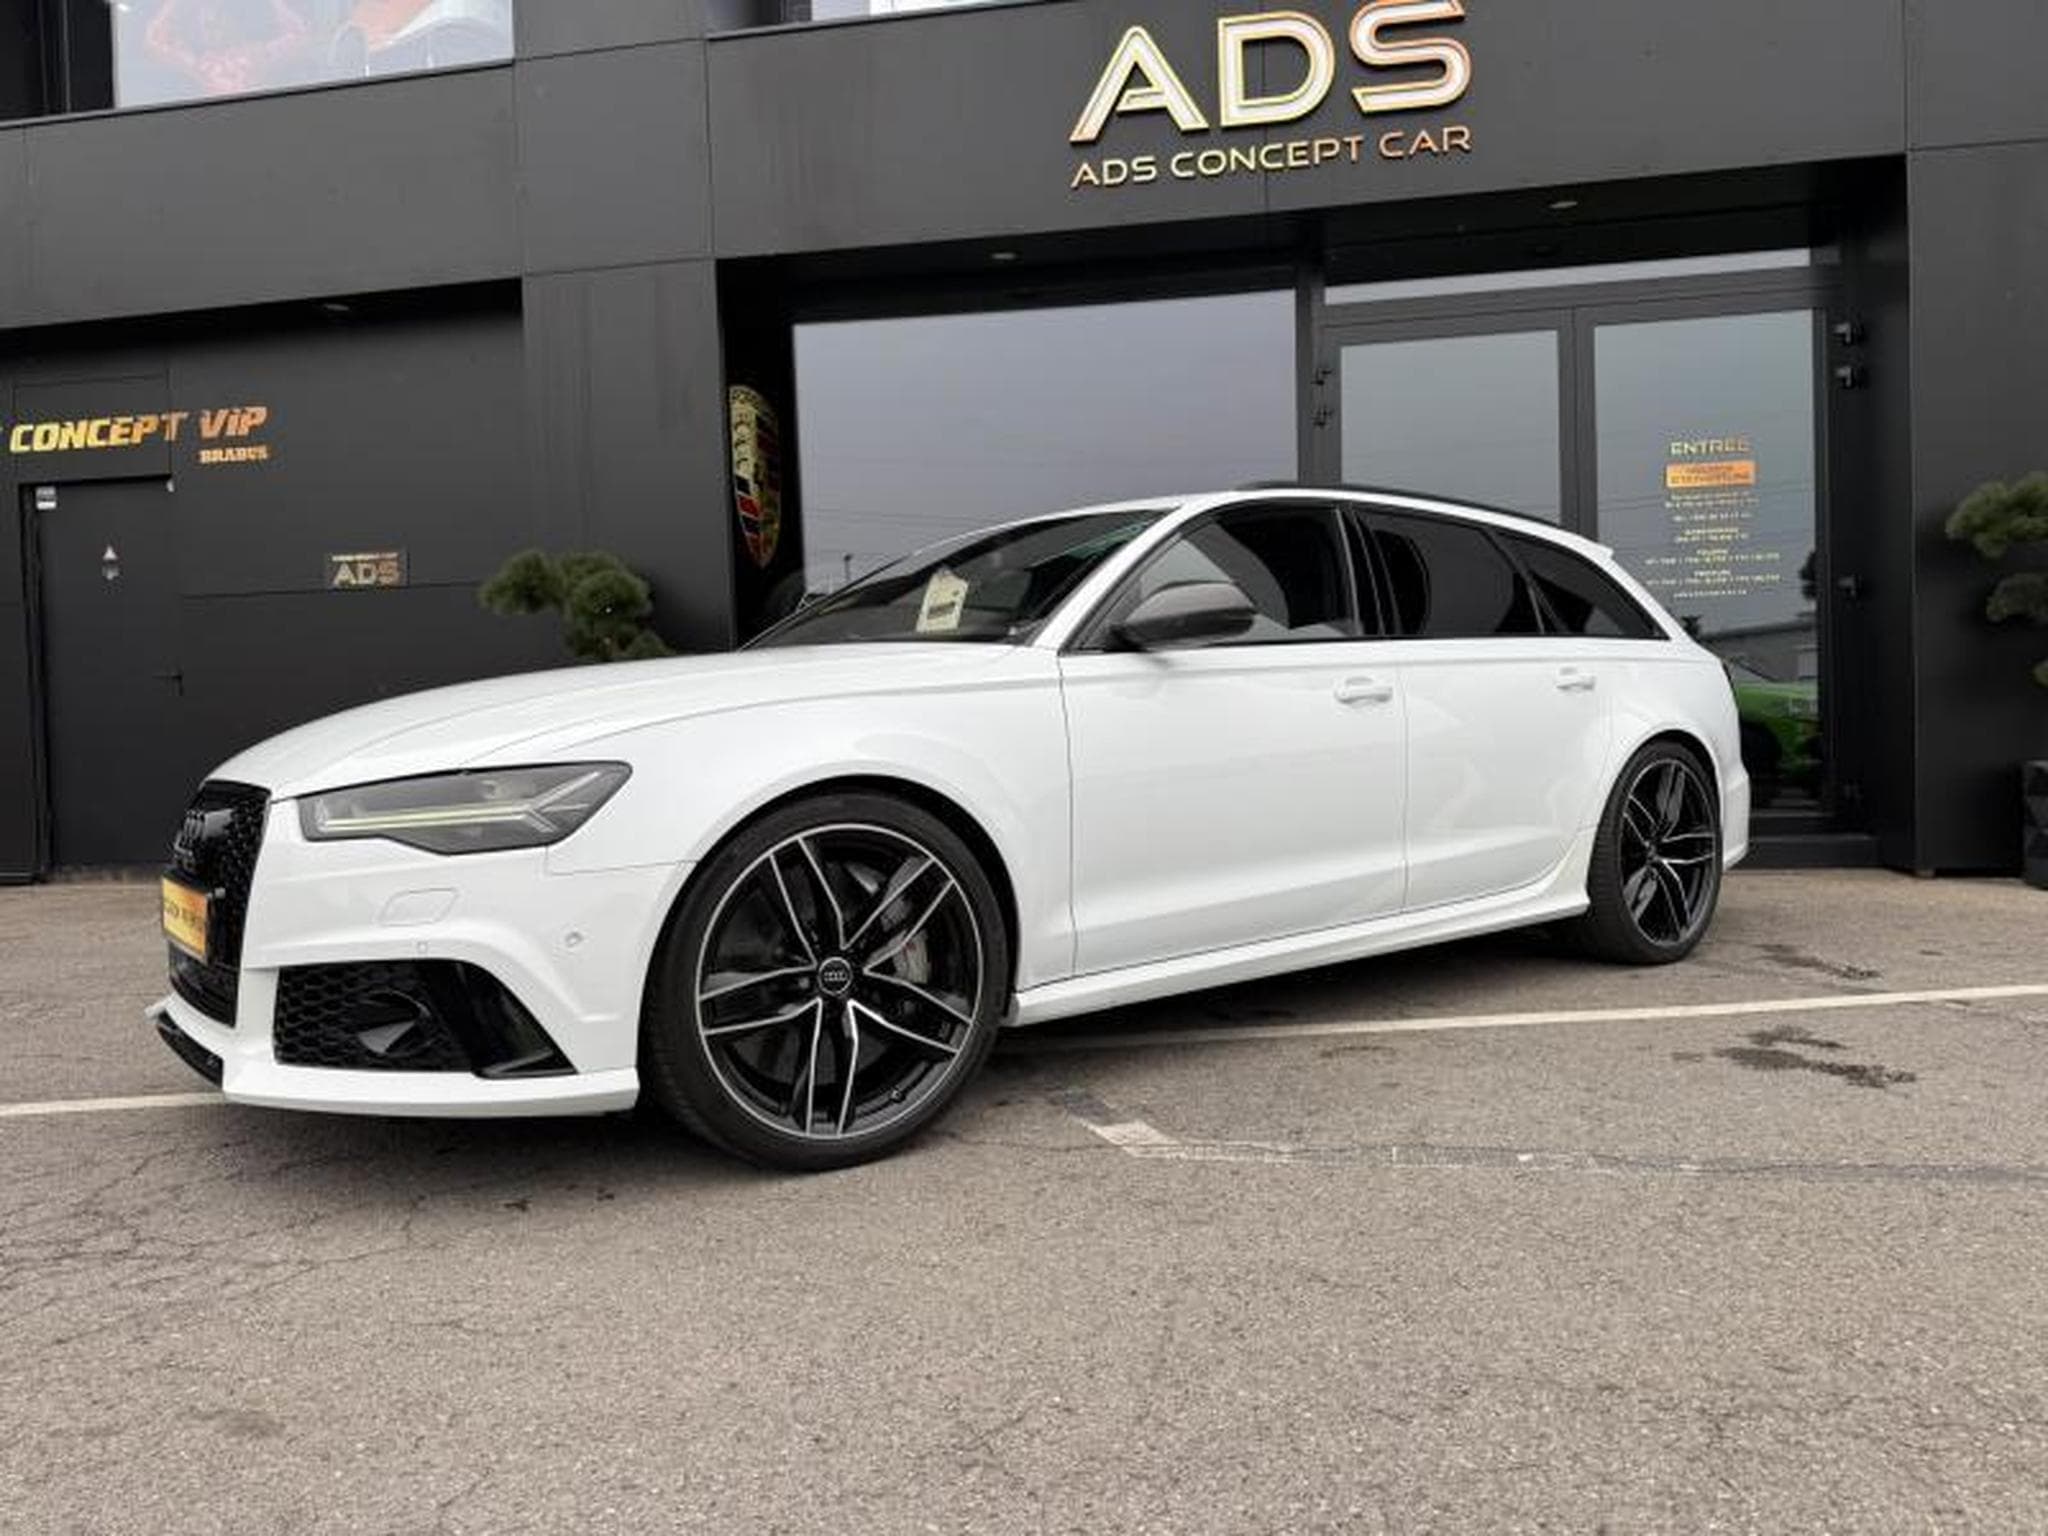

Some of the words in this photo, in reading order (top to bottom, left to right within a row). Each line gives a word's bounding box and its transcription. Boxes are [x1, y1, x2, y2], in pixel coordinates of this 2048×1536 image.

[1069, 0, 1472, 142] ADS
[1071, 155, 1157, 189] ADS
[1170, 136, 1363, 178] CONCEPT
[1379, 126, 1472, 158] CAR
[10, 412, 188, 453] CONCEPT
[333, 561, 400, 586] ADS
